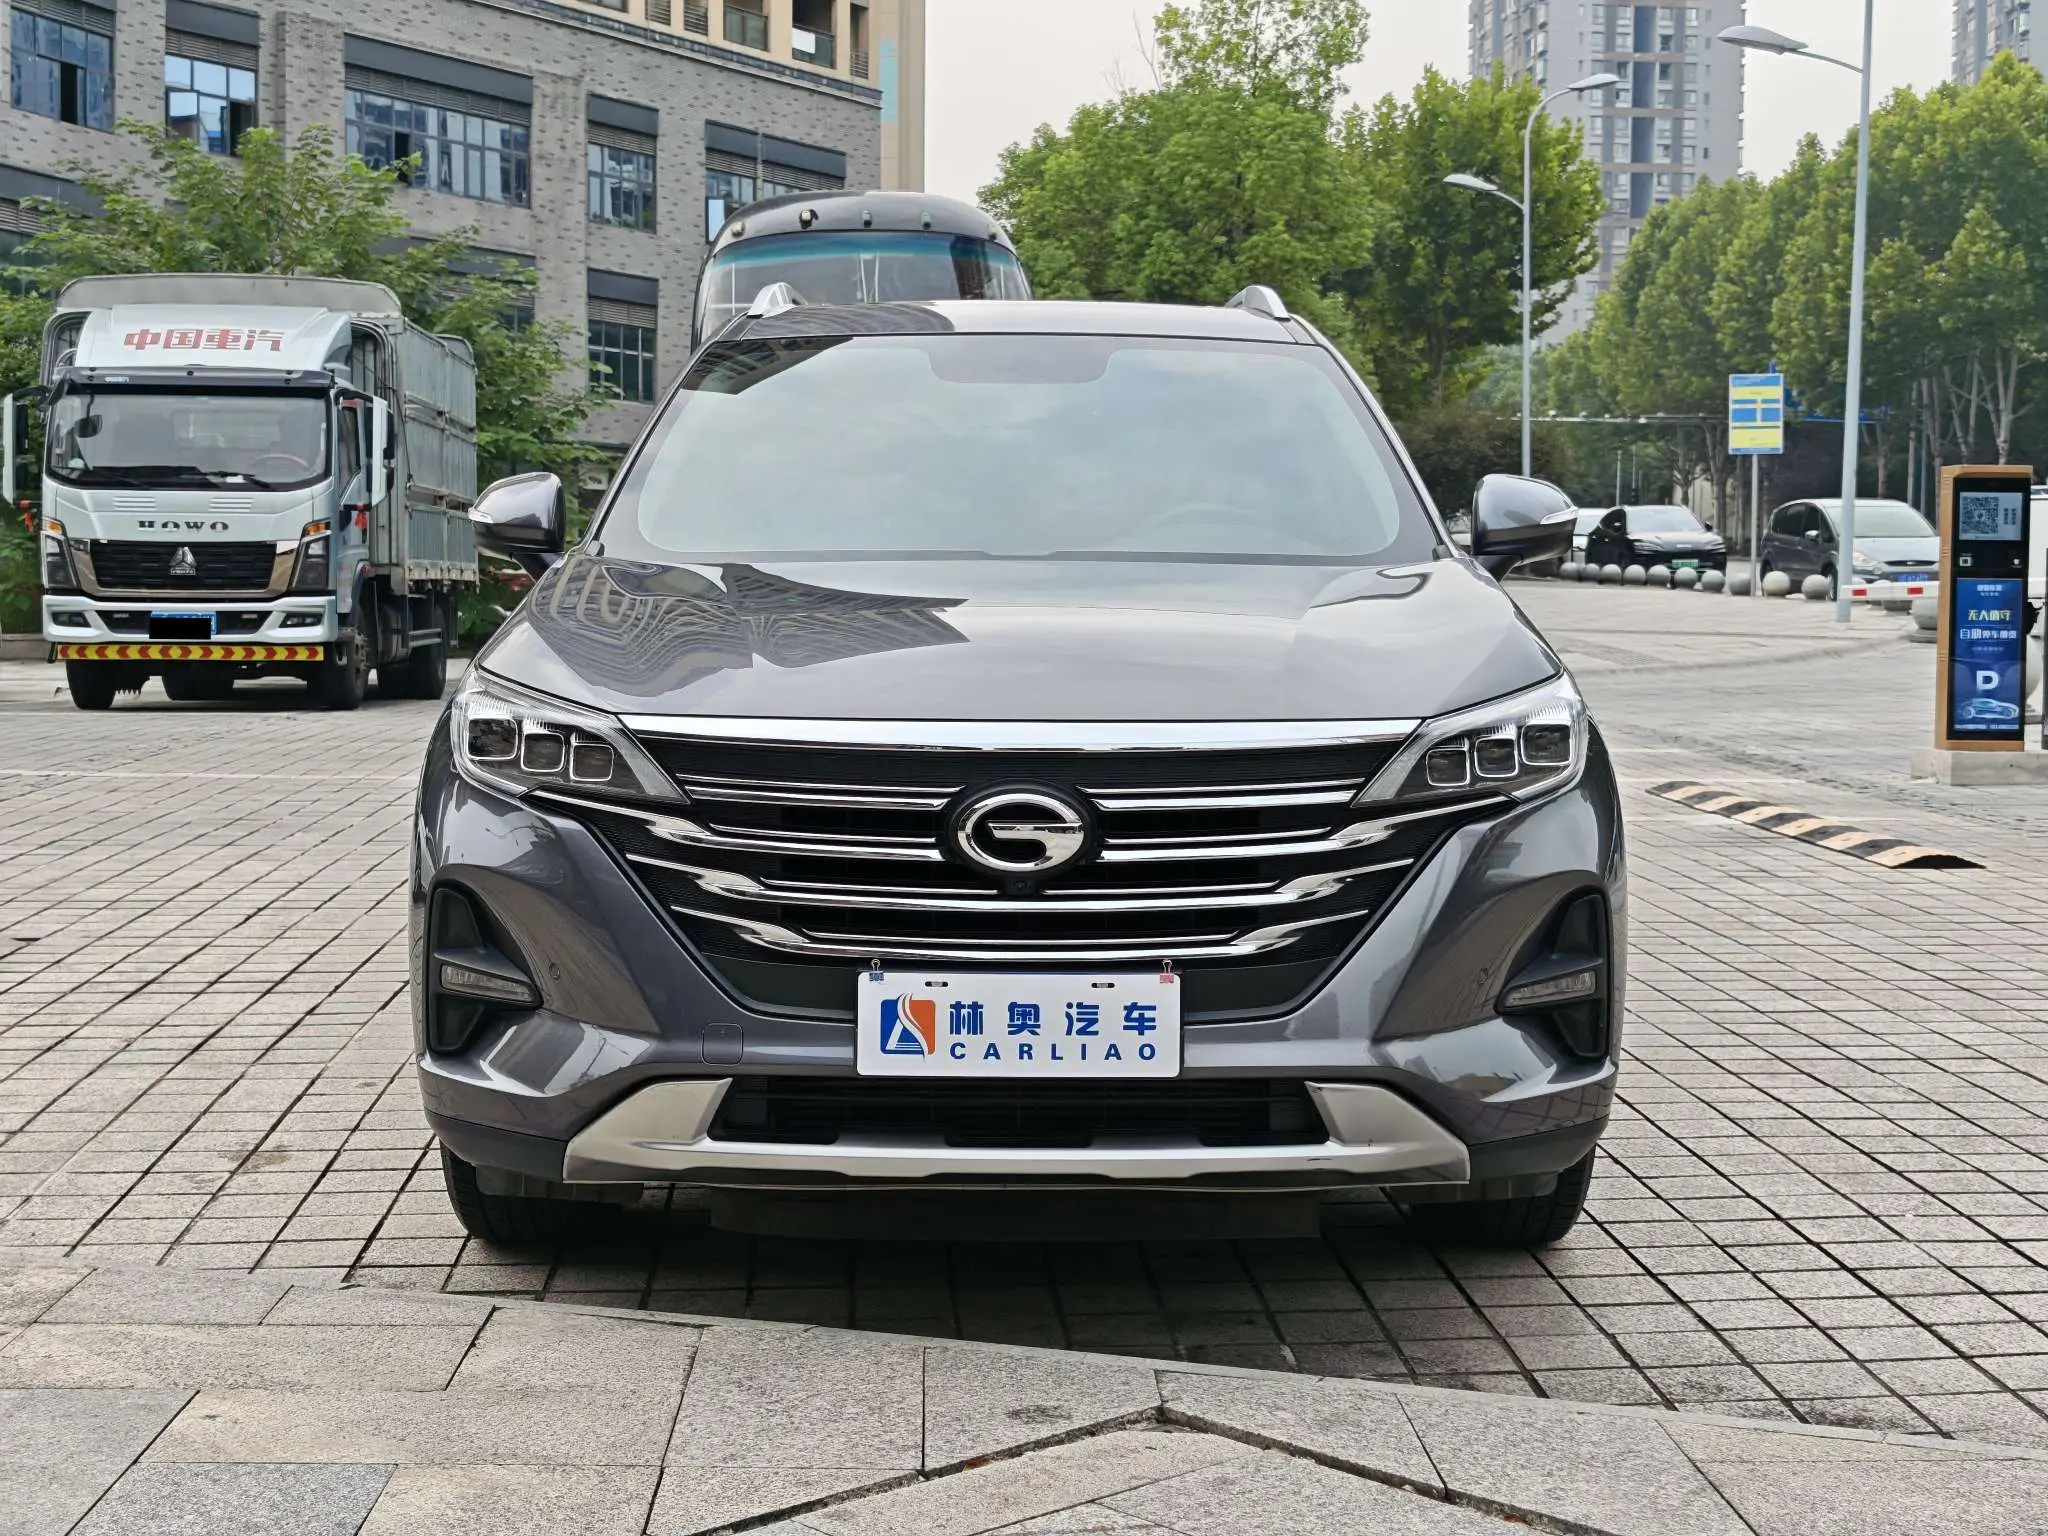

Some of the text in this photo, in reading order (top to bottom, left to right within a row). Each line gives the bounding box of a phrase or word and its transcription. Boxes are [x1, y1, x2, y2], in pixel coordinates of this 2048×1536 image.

[123, 328, 285, 352] 中国重汽
[137, 520, 230, 532] HOWO
[1976, 670, 1999, 690] D
[949, 1000, 1158, 1037] 林奥汽车
[949, 1042, 1157, 1061] CARLIAO
